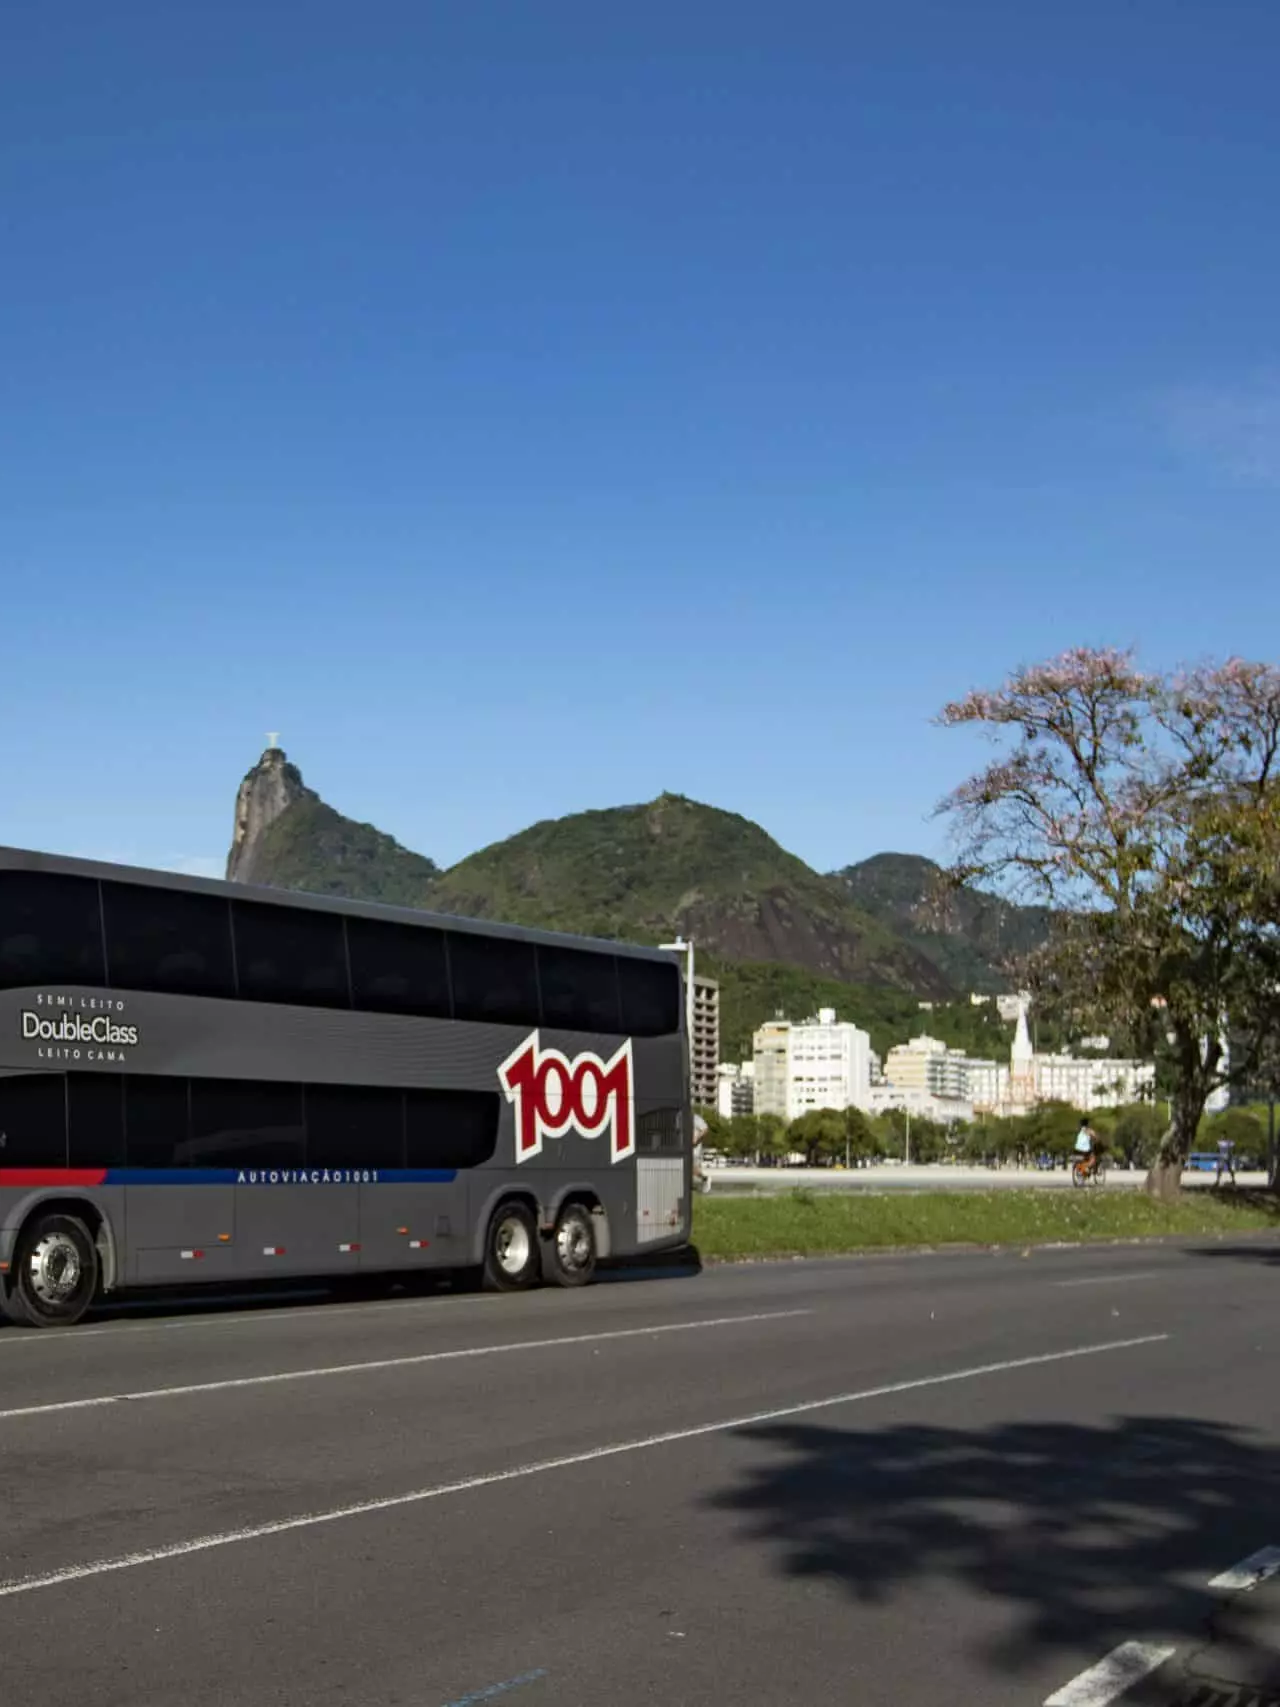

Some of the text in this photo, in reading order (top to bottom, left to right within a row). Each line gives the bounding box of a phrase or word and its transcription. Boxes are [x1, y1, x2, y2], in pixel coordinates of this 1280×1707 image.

[37, 994, 124, 1010] SEMI LEITO
[22, 1012, 138, 1044] DoubleClass
[38, 1048, 126, 1061] LEITO CAMA
[497, 1028, 635, 1164] 1001
